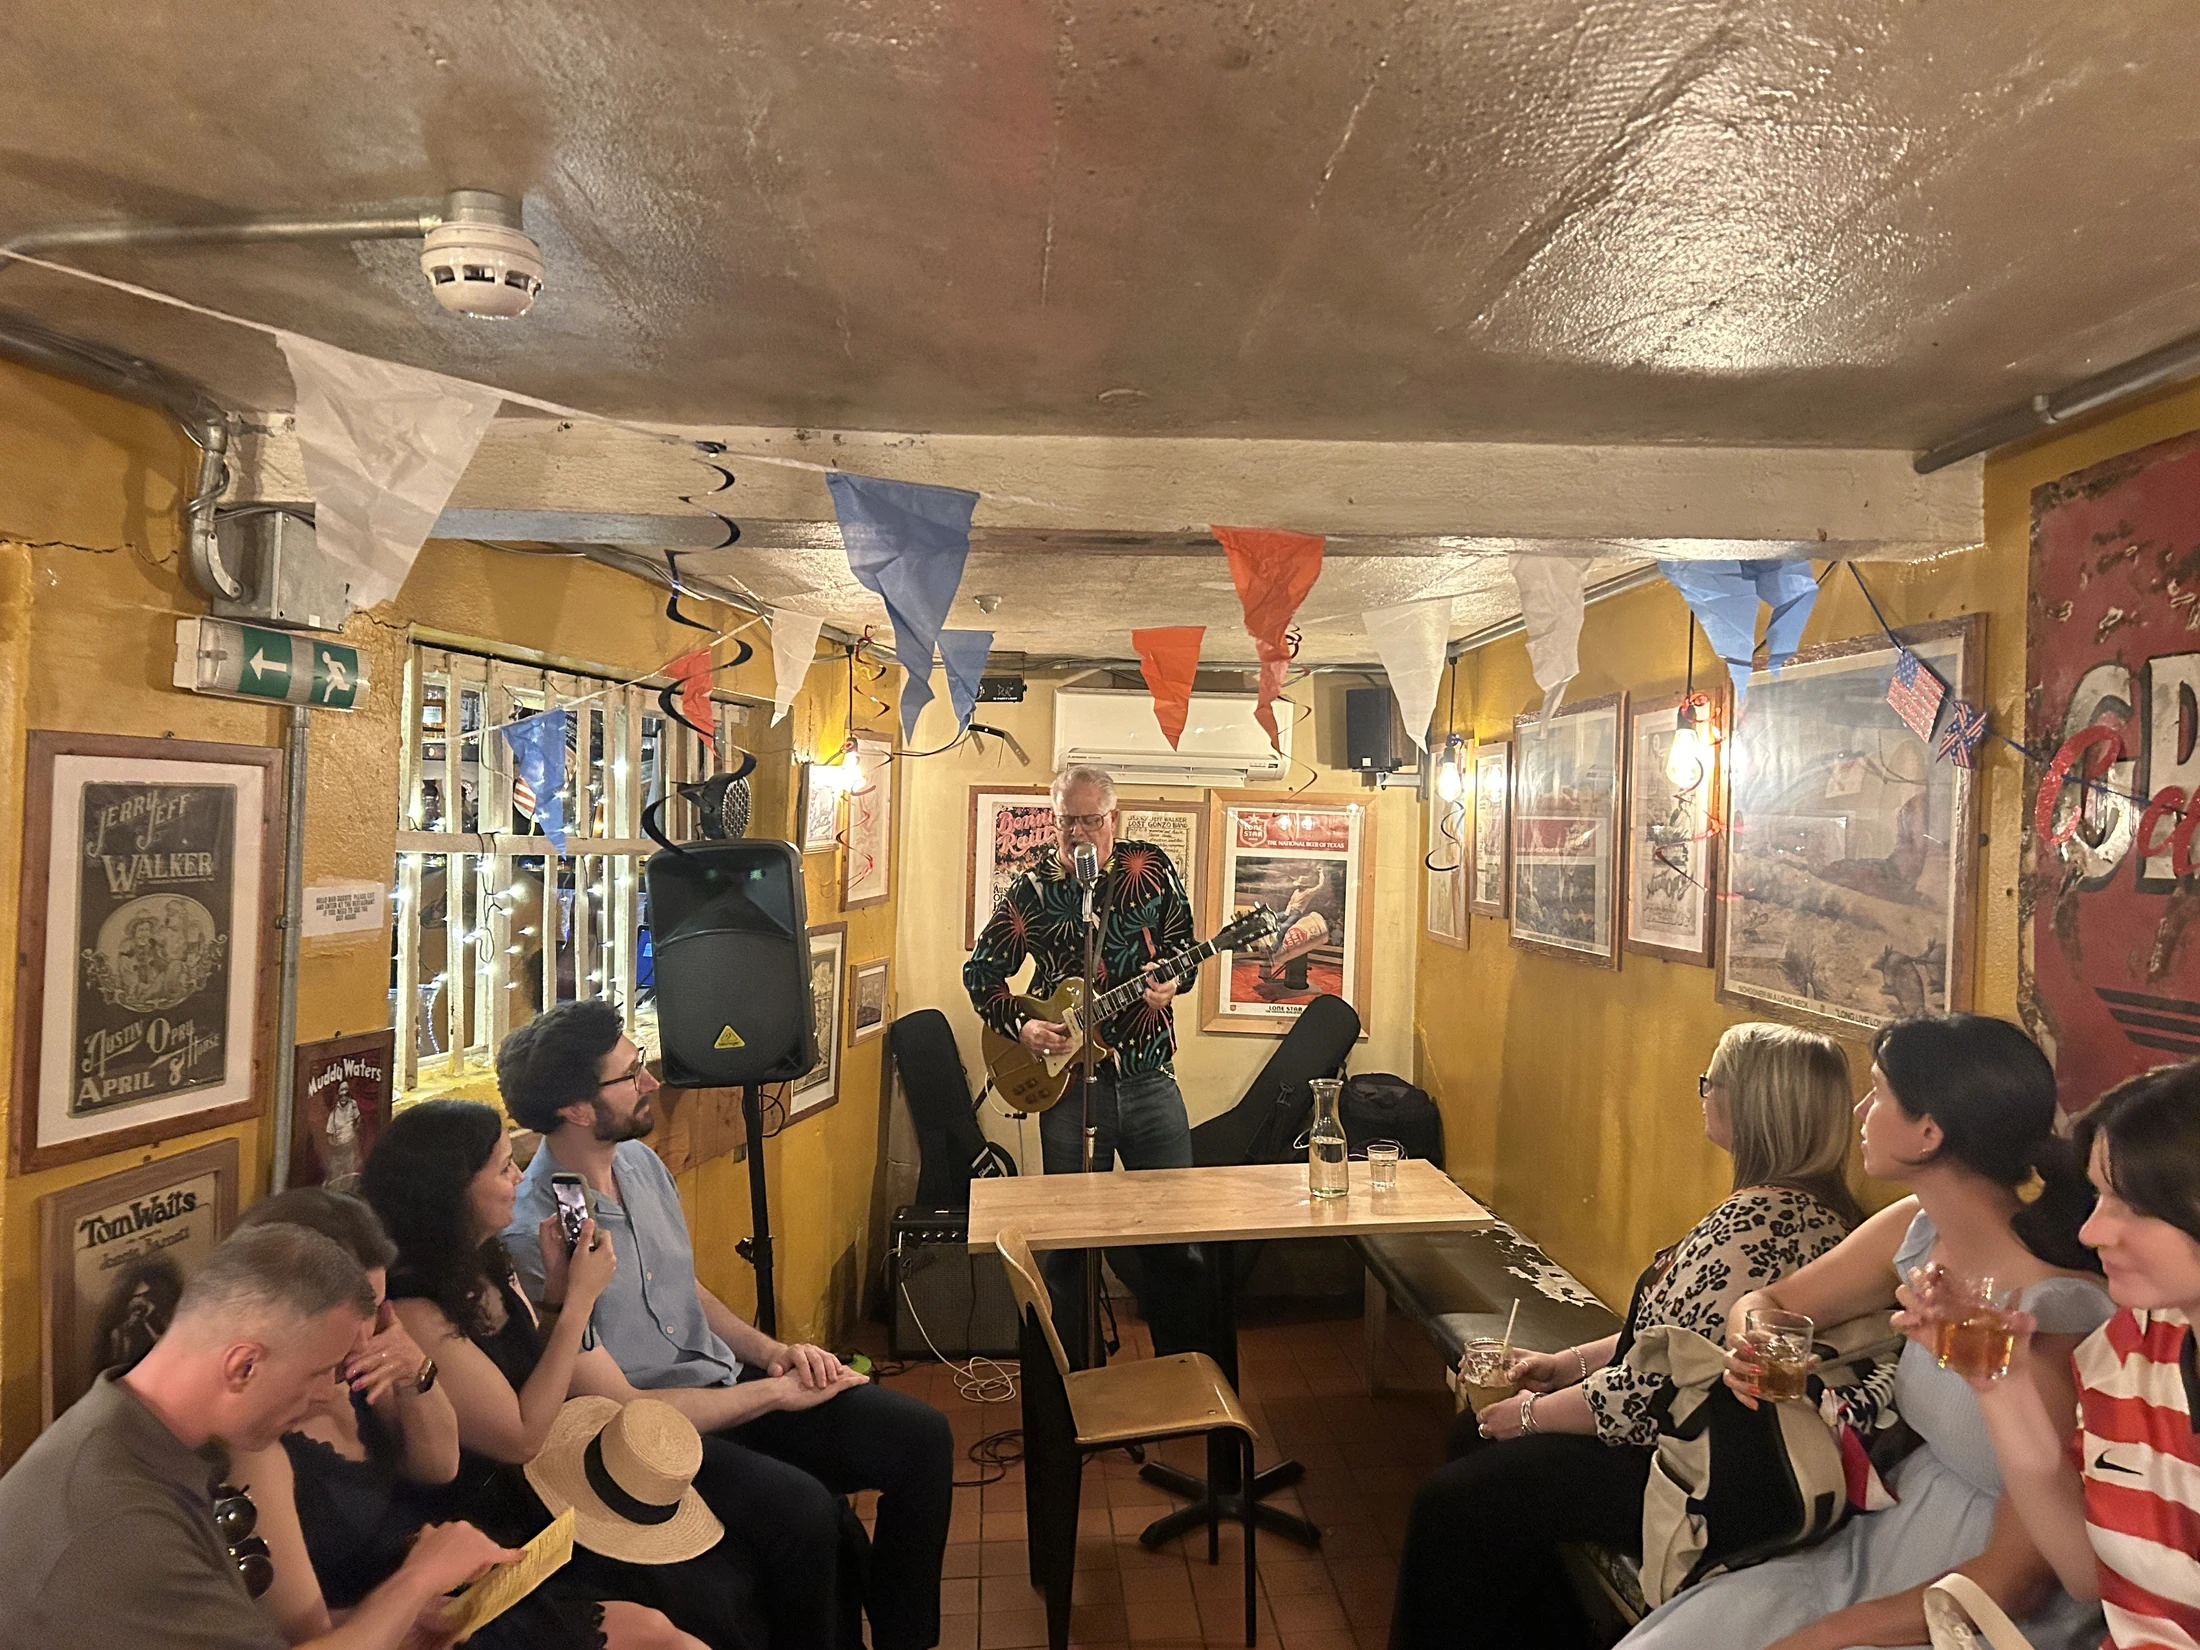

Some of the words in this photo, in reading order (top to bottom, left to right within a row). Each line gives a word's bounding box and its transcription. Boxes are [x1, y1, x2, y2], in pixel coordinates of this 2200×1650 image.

[86, 790, 158, 858] JERRY
[136, 792, 190, 850] JEFF
[996, 810, 1054, 834] Bonni
[996, 825, 1059, 857] Raitt
[1243, 824, 1263, 832] LONE
[1243, 830, 1263, 838] STAR
[101, 852, 214, 893] WALKER
[1738, 985, 1767, 998] SCHOONER
[81, 1020, 144, 1078] AUSTIN
[146, 1017, 195, 1054] OPRY
[188, 1033, 221, 1068] HOUSE
[75, 1071, 155, 1106] APRIL
[169, 1051, 185, 1086] 8
[308, 1063, 343, 1098] Muddy
[343, 1058, 382, 1082] Waters
[78, 1214, 138, 1249] Tom
[130, 1191, 197, 1230] Waits
